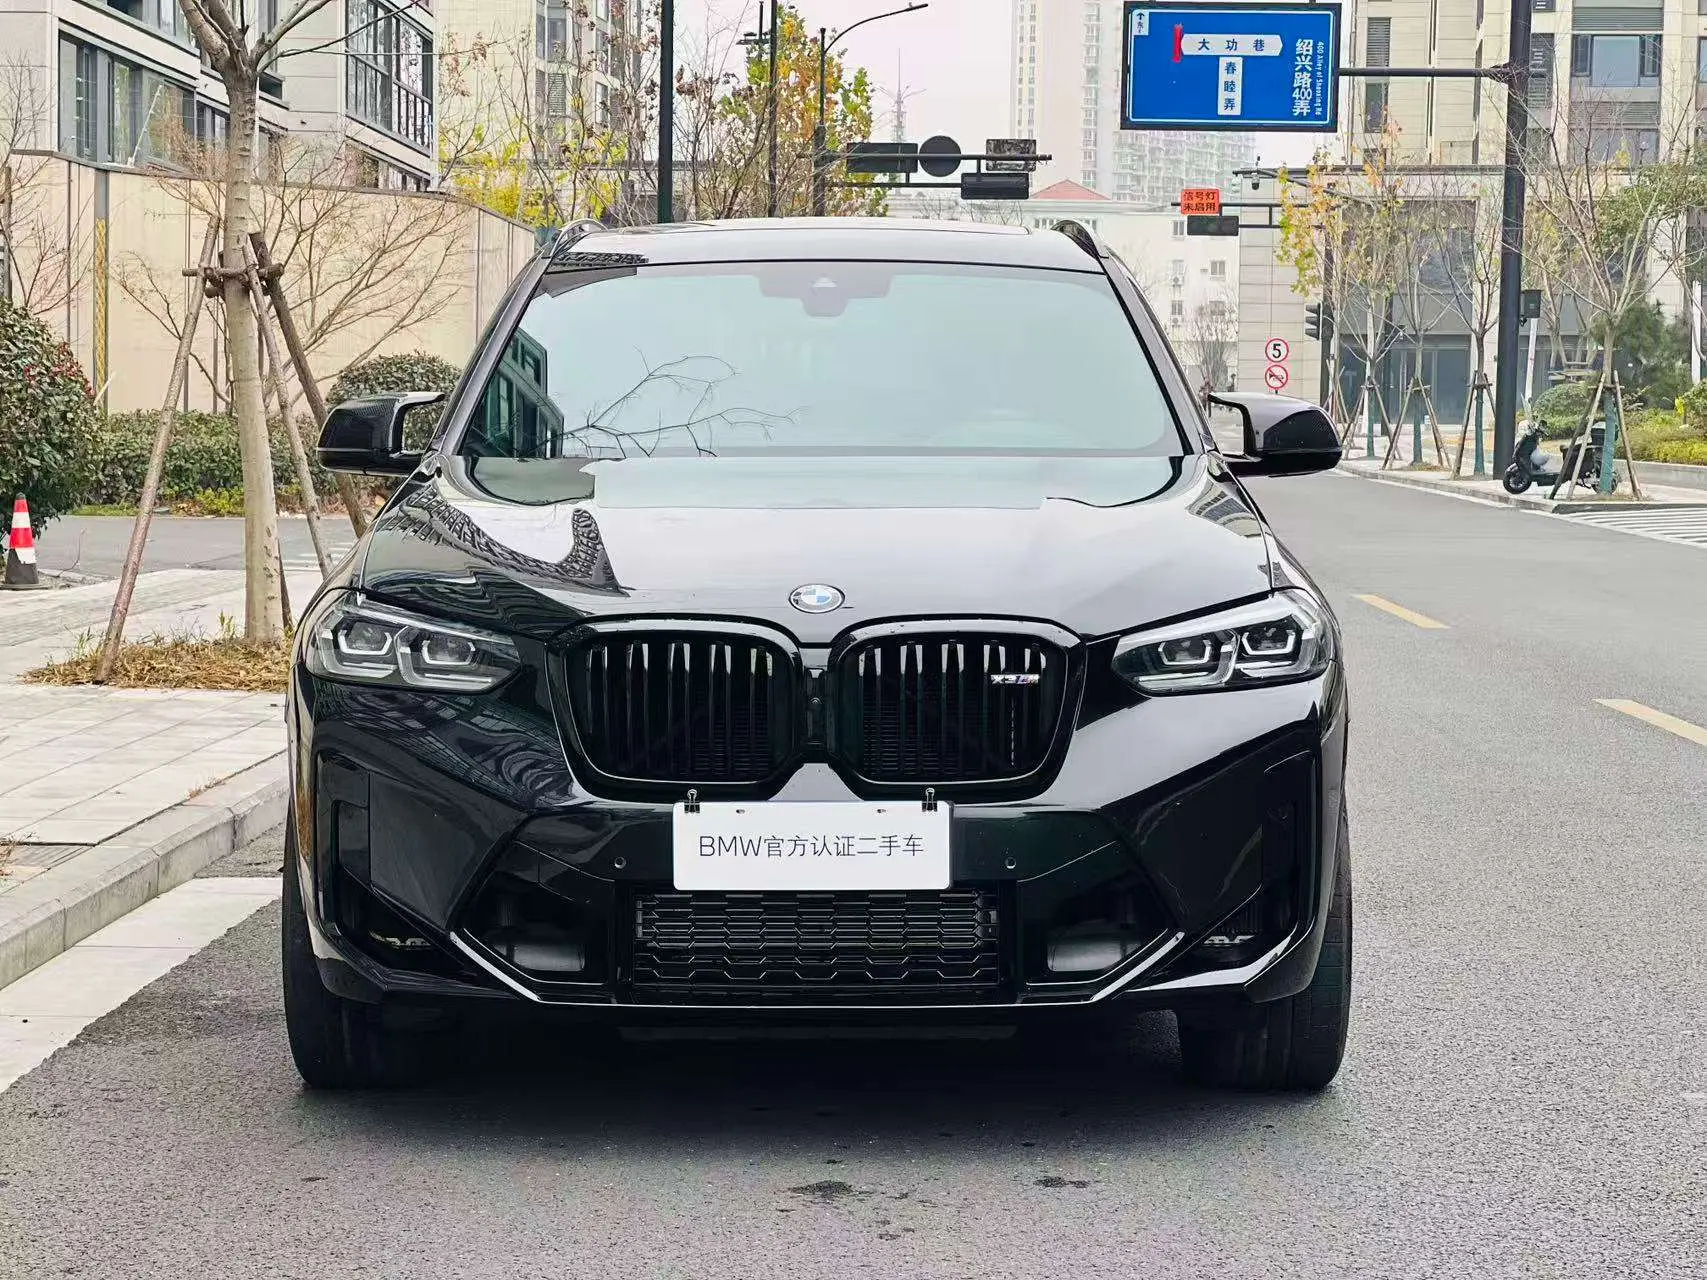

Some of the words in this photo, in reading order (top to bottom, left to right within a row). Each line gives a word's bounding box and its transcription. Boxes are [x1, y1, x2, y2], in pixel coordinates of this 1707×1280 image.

[1198, 38, 1265, 51] 大功巷
[1316, 41, 1325, 54] 400
[1314, 54, 1324, 71] Alley
[1292, 39, 1313, 116] 绍兴路400弄
[1223, 61, 1237, 111] 春睦弄
[1183, 191, 1216, 201] 信号灯
[1183, 202, 1216, 212] 未启用
[1272, 343, 1281, 358] 5
[699, 834, 924, 857] BMW官方认证二手车
